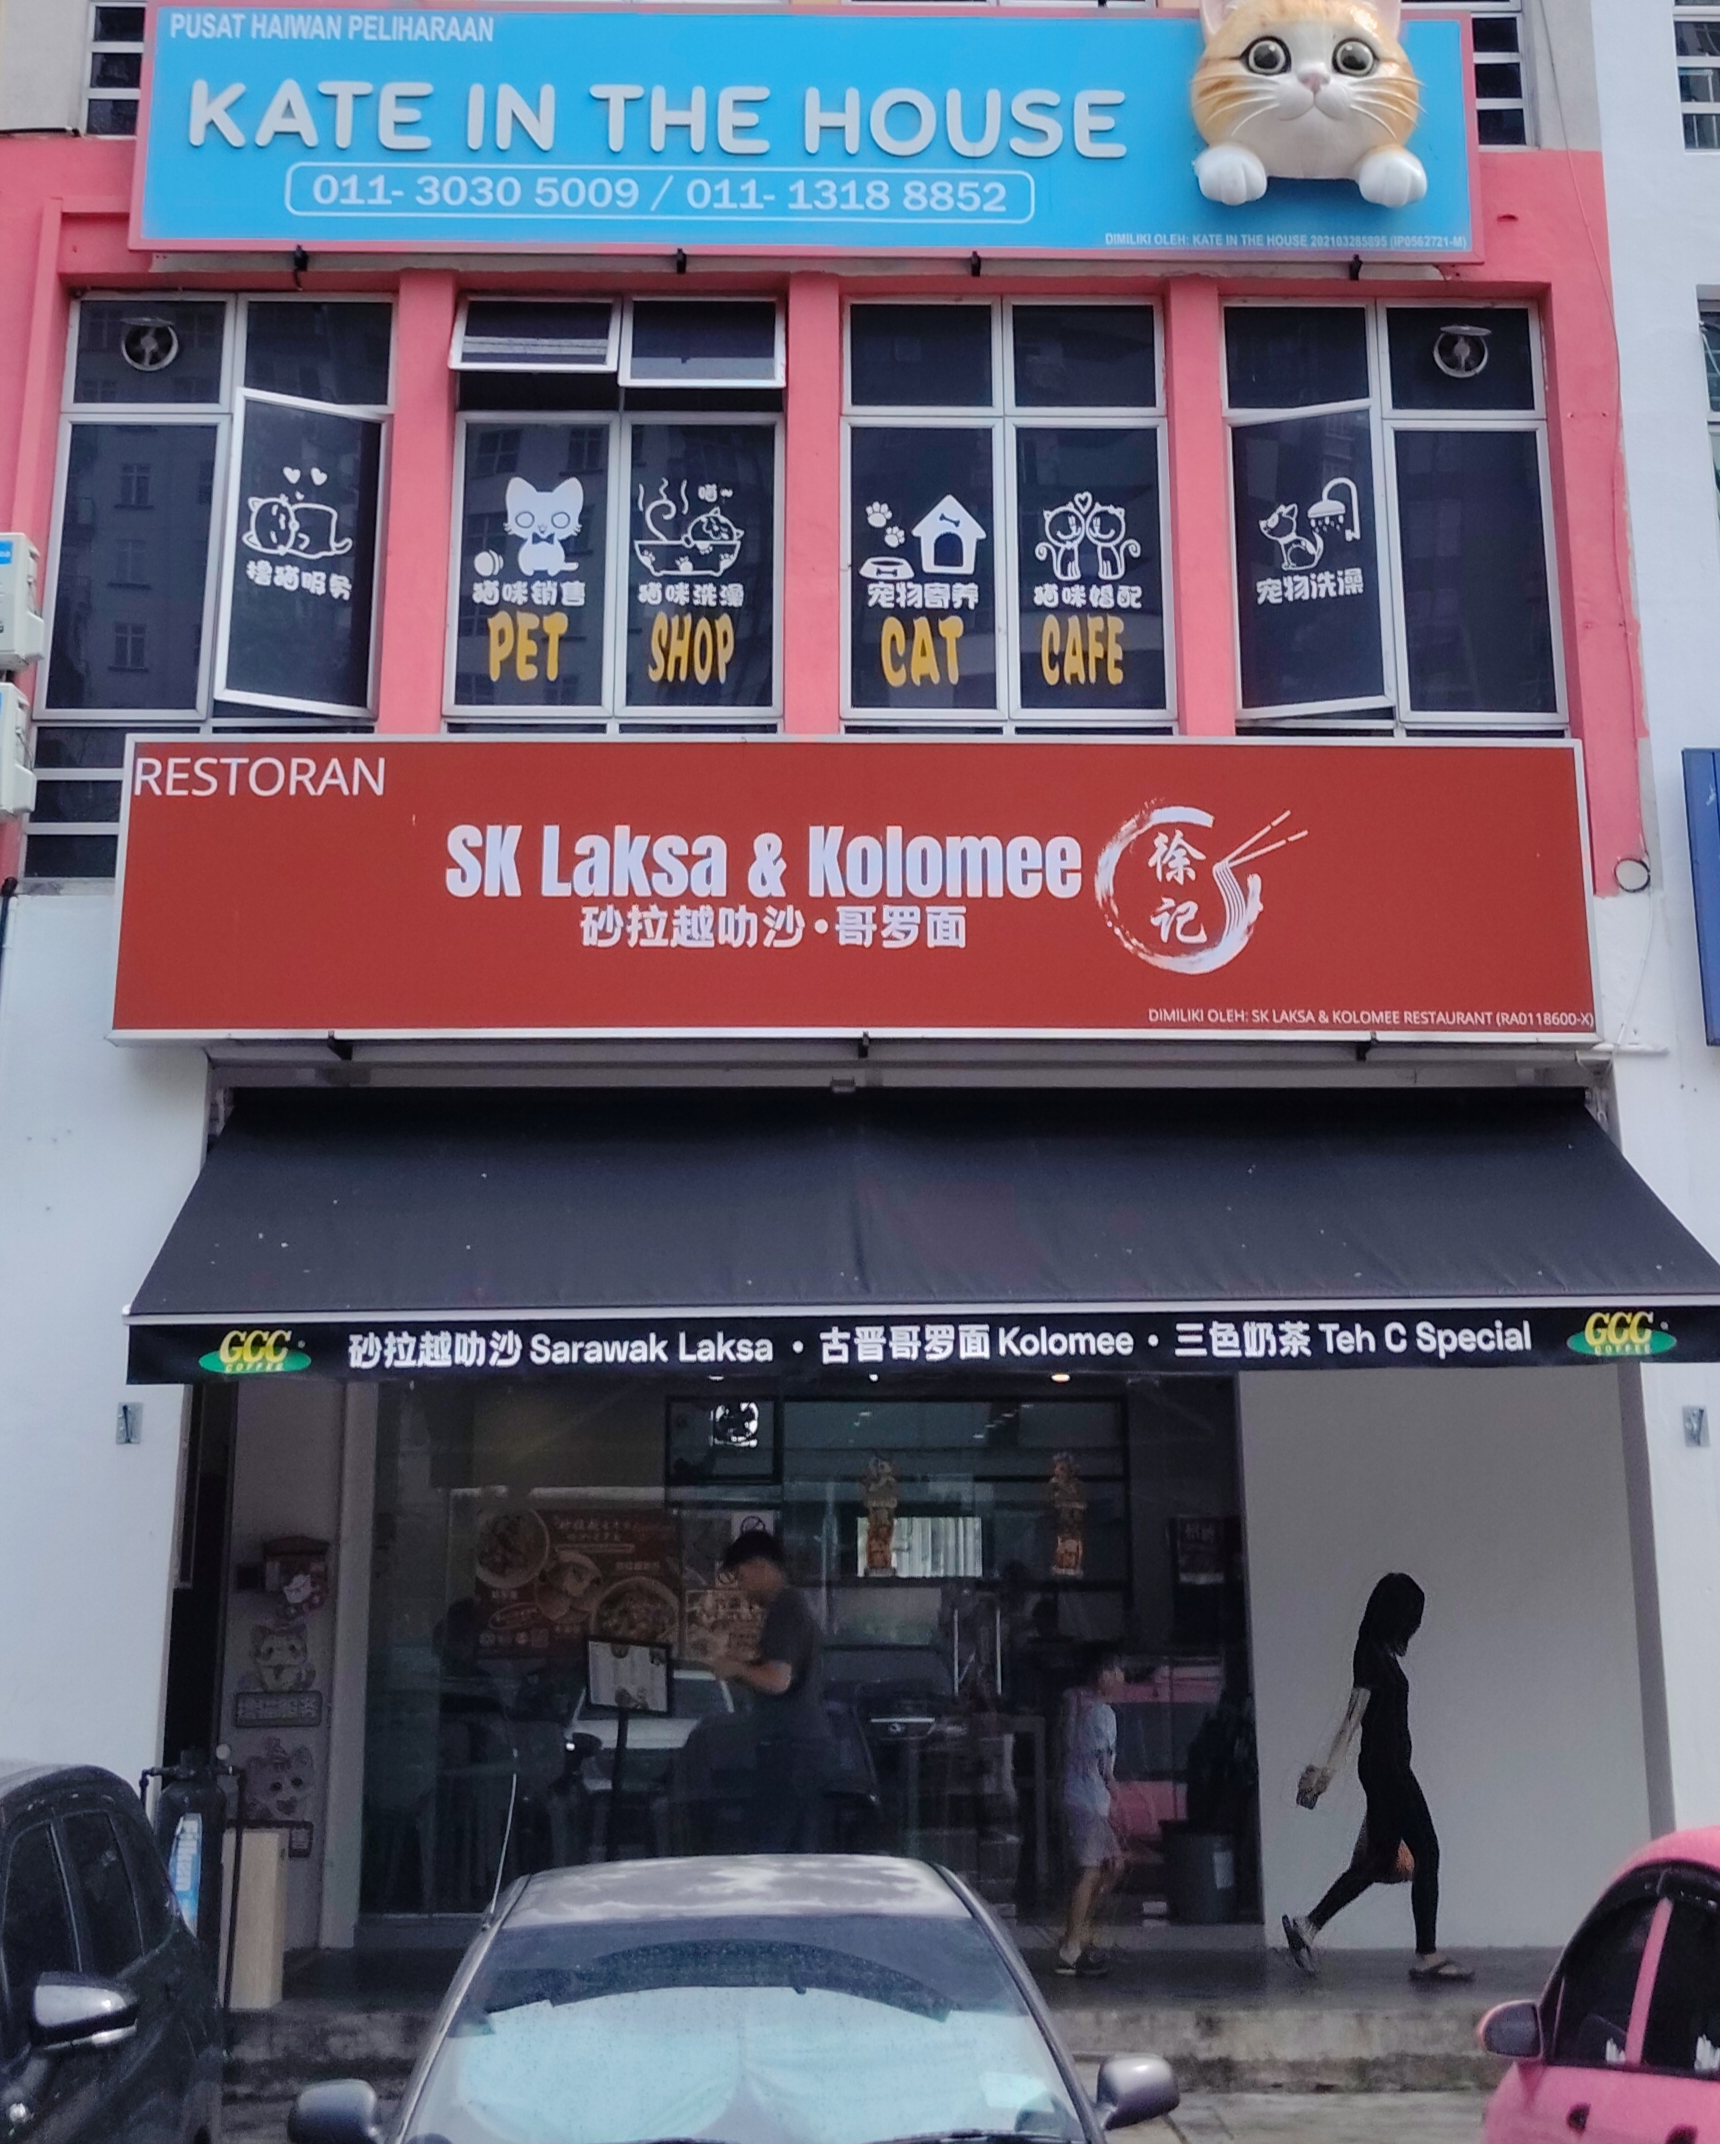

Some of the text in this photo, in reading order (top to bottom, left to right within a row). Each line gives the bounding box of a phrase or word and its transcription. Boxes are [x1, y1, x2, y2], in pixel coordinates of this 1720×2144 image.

[169, 13, 494, 42] PUSAT HAIWAN PELIHARAAN
[187, 78, 1127, 159] KATE IN THE HOUSE
[312, 173, 405, 207] 011-
[415, 176, 520, 208] 3030
[534, 177, 640, 209] 5009
[686, 179, 776, 210] 011-
[788, 180, 890, 212] 1318
[903, 181, 1007, 213] 8852
[1105, 232, 1150, 246] DIMILIKI
[1154, 233, 1189, 246] OLEH:
[1193, 234, 1223, 247] KATE
[1226, 234, 1238, 247] IN
[1240, 234, 1264, 247] THE
[1267, 234, 1307, 248] HOUSE
[472, 580, 586, 606] 猫咪销售
[867, 582, 979, 610] 宠物寄养
[1256, 567, 1365, 606] 宠物洗澡
[487, 610, 569, 683] PET
[649, 611, 735, 685] SHOP
[880, 615, 965, 688] CAT
[1041, 613, 1125, 686] CAFE
[133, 757, 386, 796] RESTORAN
[445, 824, 1083, 900] SK Laksa & Kolomee
[1148, 1008, 1594, 1028] DIMILIKI OLEH: SK LAKSA & KOLOMEE RESTAURANT (RA0118600-X)
[219, 1329, 293, 1363] GCC
[348, 1319, 1532, 1369] 砂拉越叻沙 Sarawak Laksa 古晋哥罗面 Kolomee 三色奶茶 Teh C Special
[1584, 1311, 1655, 1345] GCC
